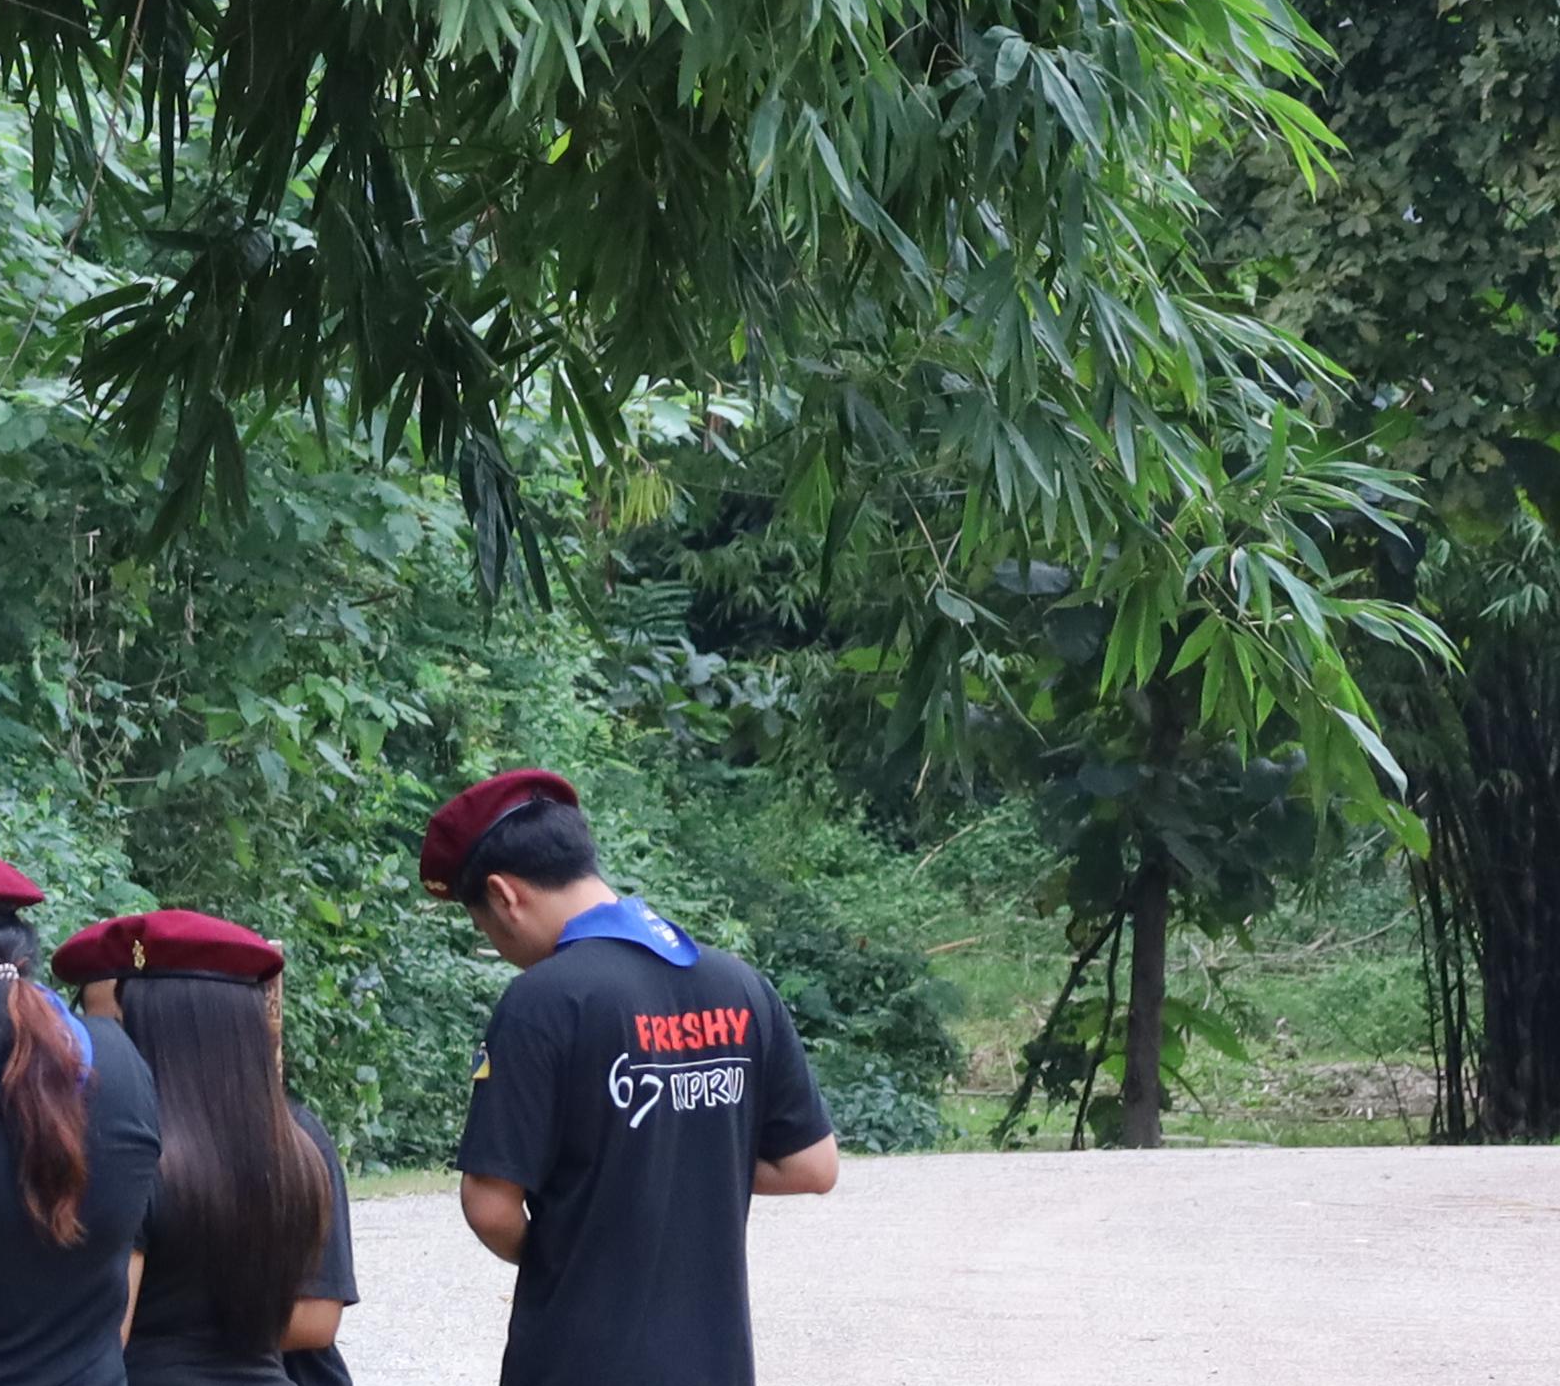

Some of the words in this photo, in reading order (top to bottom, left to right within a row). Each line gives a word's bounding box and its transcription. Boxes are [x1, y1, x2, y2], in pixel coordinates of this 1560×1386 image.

[634, 1007, 752, 1053] FRESHY
[608, 1053, 665, 1129] 67
[670, 1067, 744, 1111] KPRU
